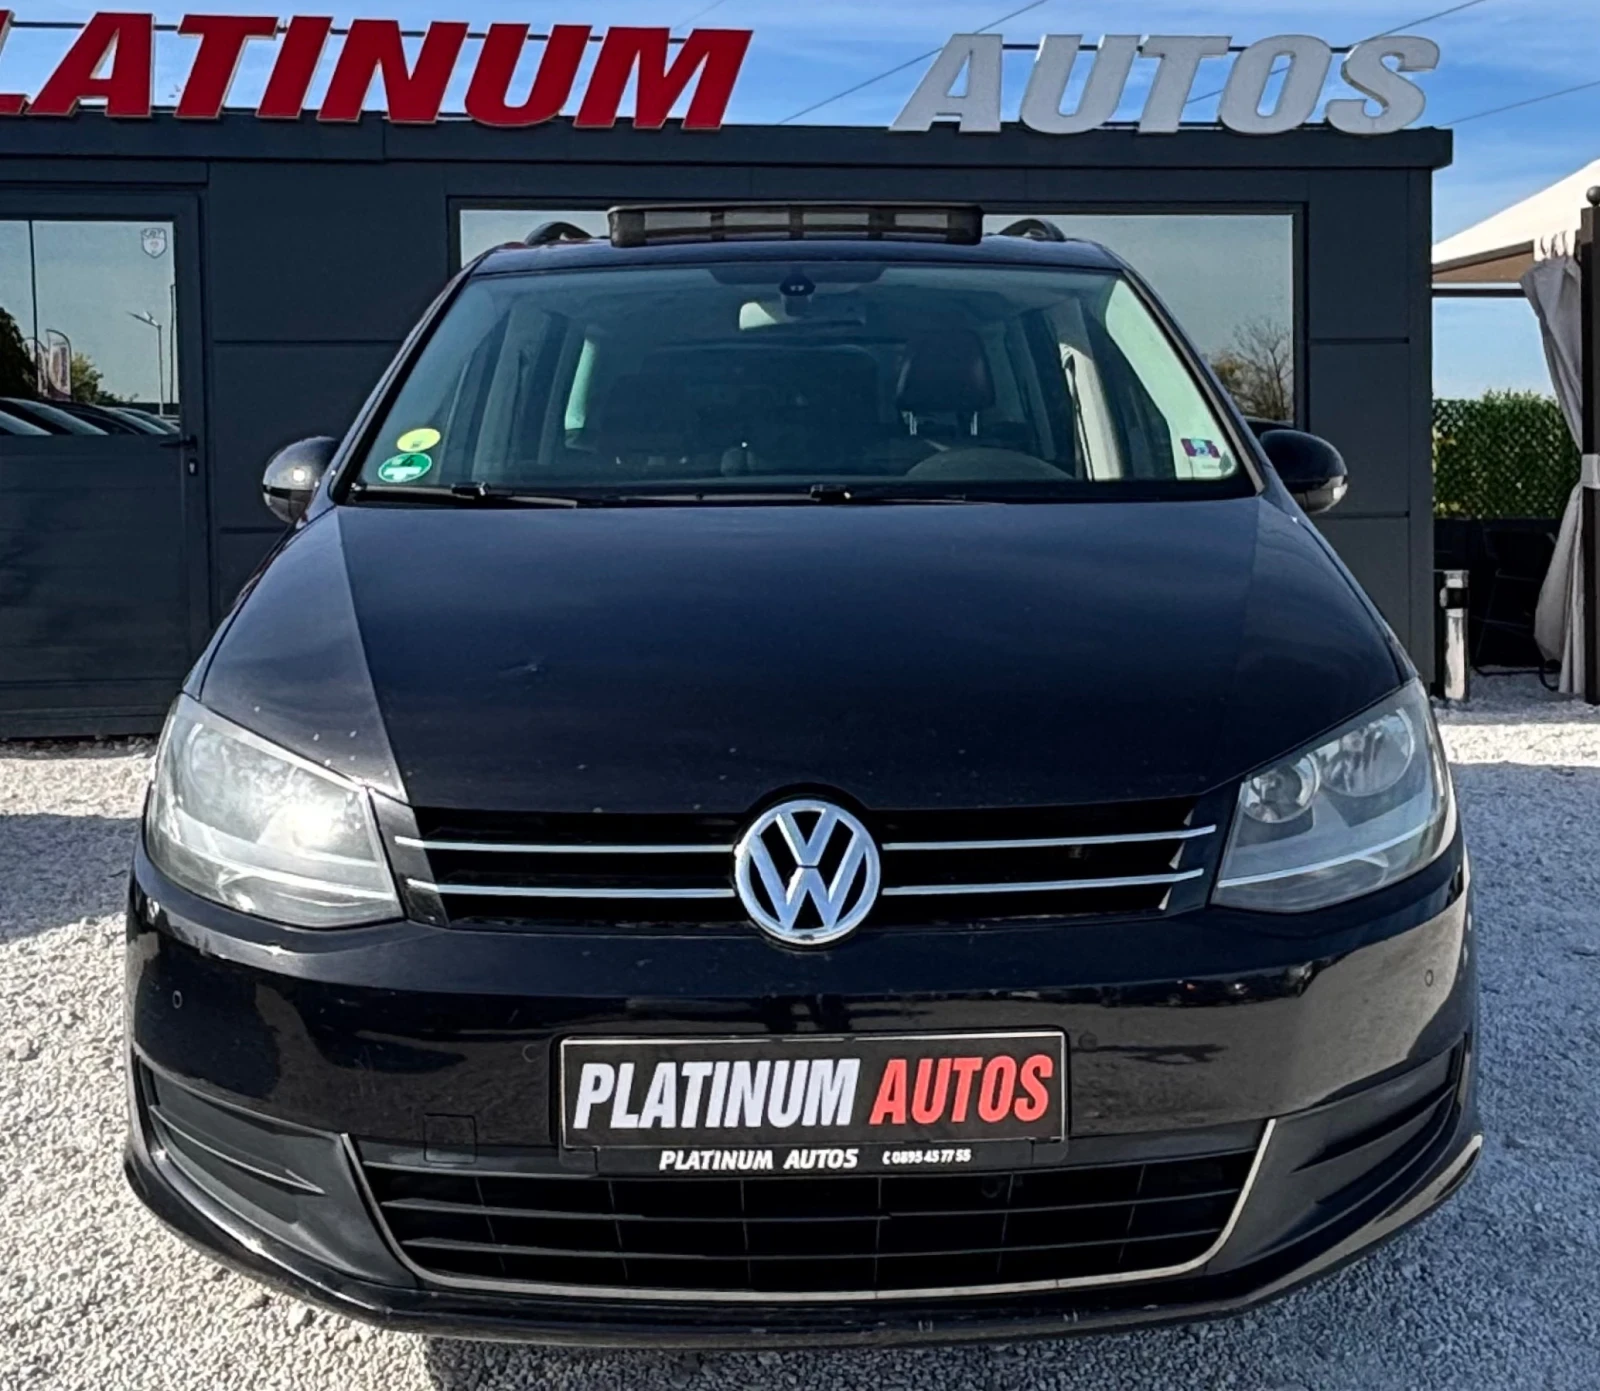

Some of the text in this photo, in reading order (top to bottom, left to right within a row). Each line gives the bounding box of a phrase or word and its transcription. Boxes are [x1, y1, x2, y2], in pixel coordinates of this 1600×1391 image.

[889, 33, 1440, 135] AUTOS
[737, 800, 881, 944] VW
[573, 1054, 1054, 1129] PLATINUM AUTOS
[659, 1148, 859, 1171] PLATINUM AUTOS
